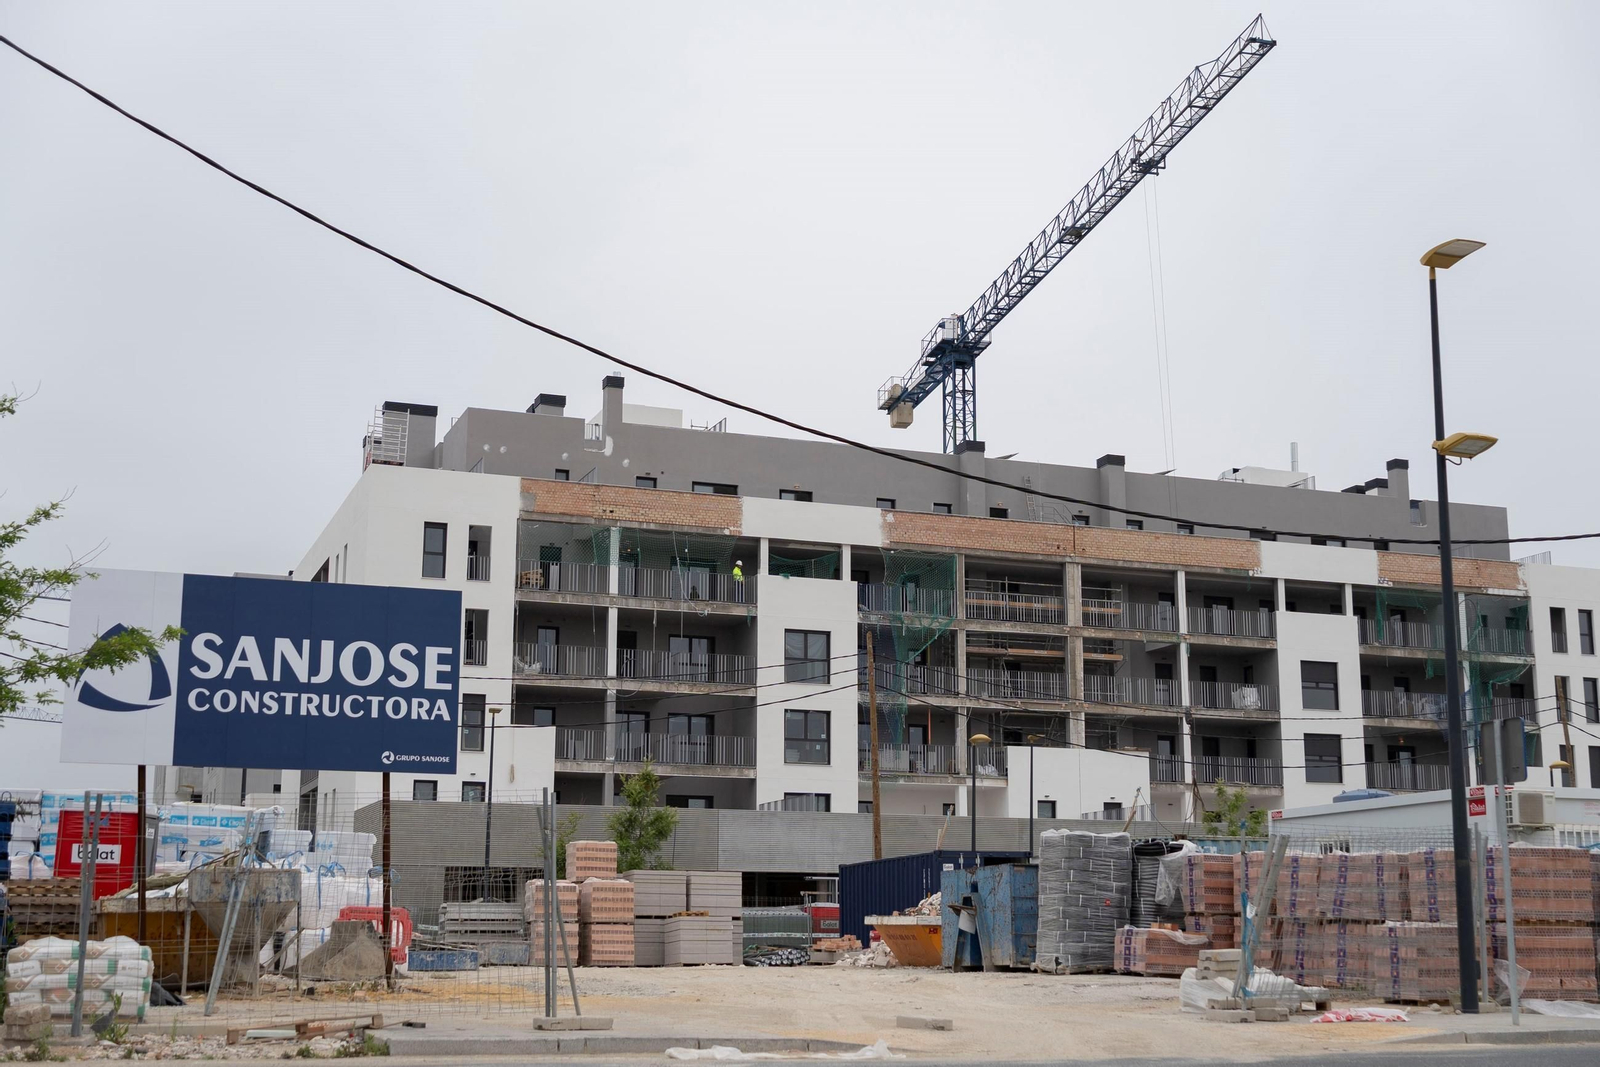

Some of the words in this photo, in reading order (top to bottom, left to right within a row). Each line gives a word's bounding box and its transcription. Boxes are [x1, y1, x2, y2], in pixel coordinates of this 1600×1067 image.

[189, 632, 453, 691] SANJOSE
[187, 687, 451, 721] CONSTRUCTORA
[395, 754, 421, 762] GRUPO
[421, 755, 450, 763] SANJOSE
